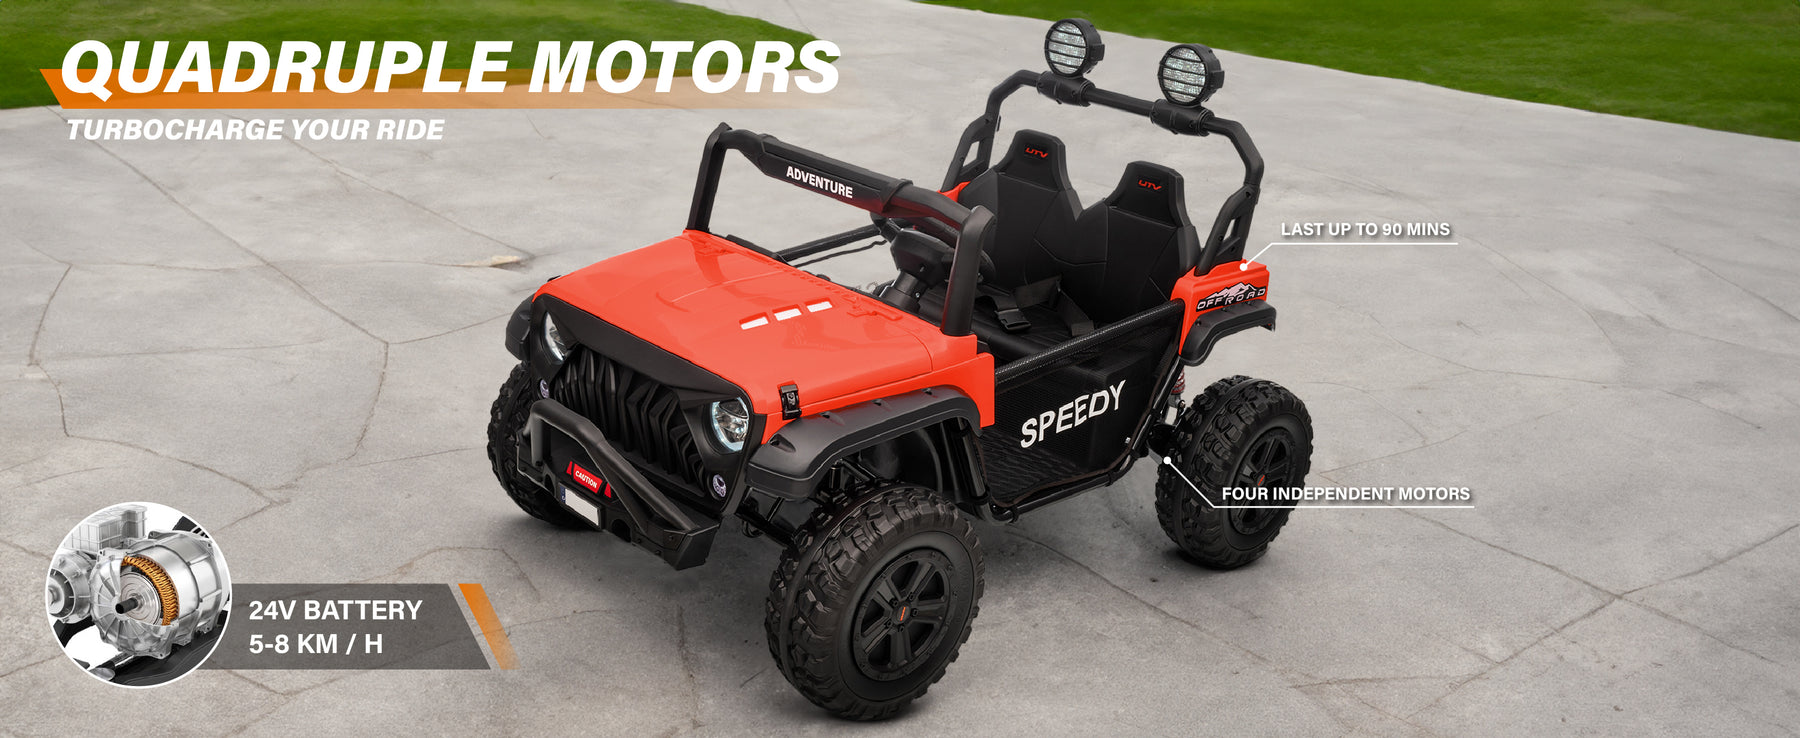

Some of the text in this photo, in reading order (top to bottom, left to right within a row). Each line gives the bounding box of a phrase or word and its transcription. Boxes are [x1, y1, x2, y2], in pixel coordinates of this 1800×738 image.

[1025, 147, 1048, 159] UTV
[786, 165, 853, 199] ADVENTURE
[1138, 179, 1162, 191] UTV
[1020, 380, 1126, 449] SPEEDY
[575, 469, 598, 489] CAUTION
